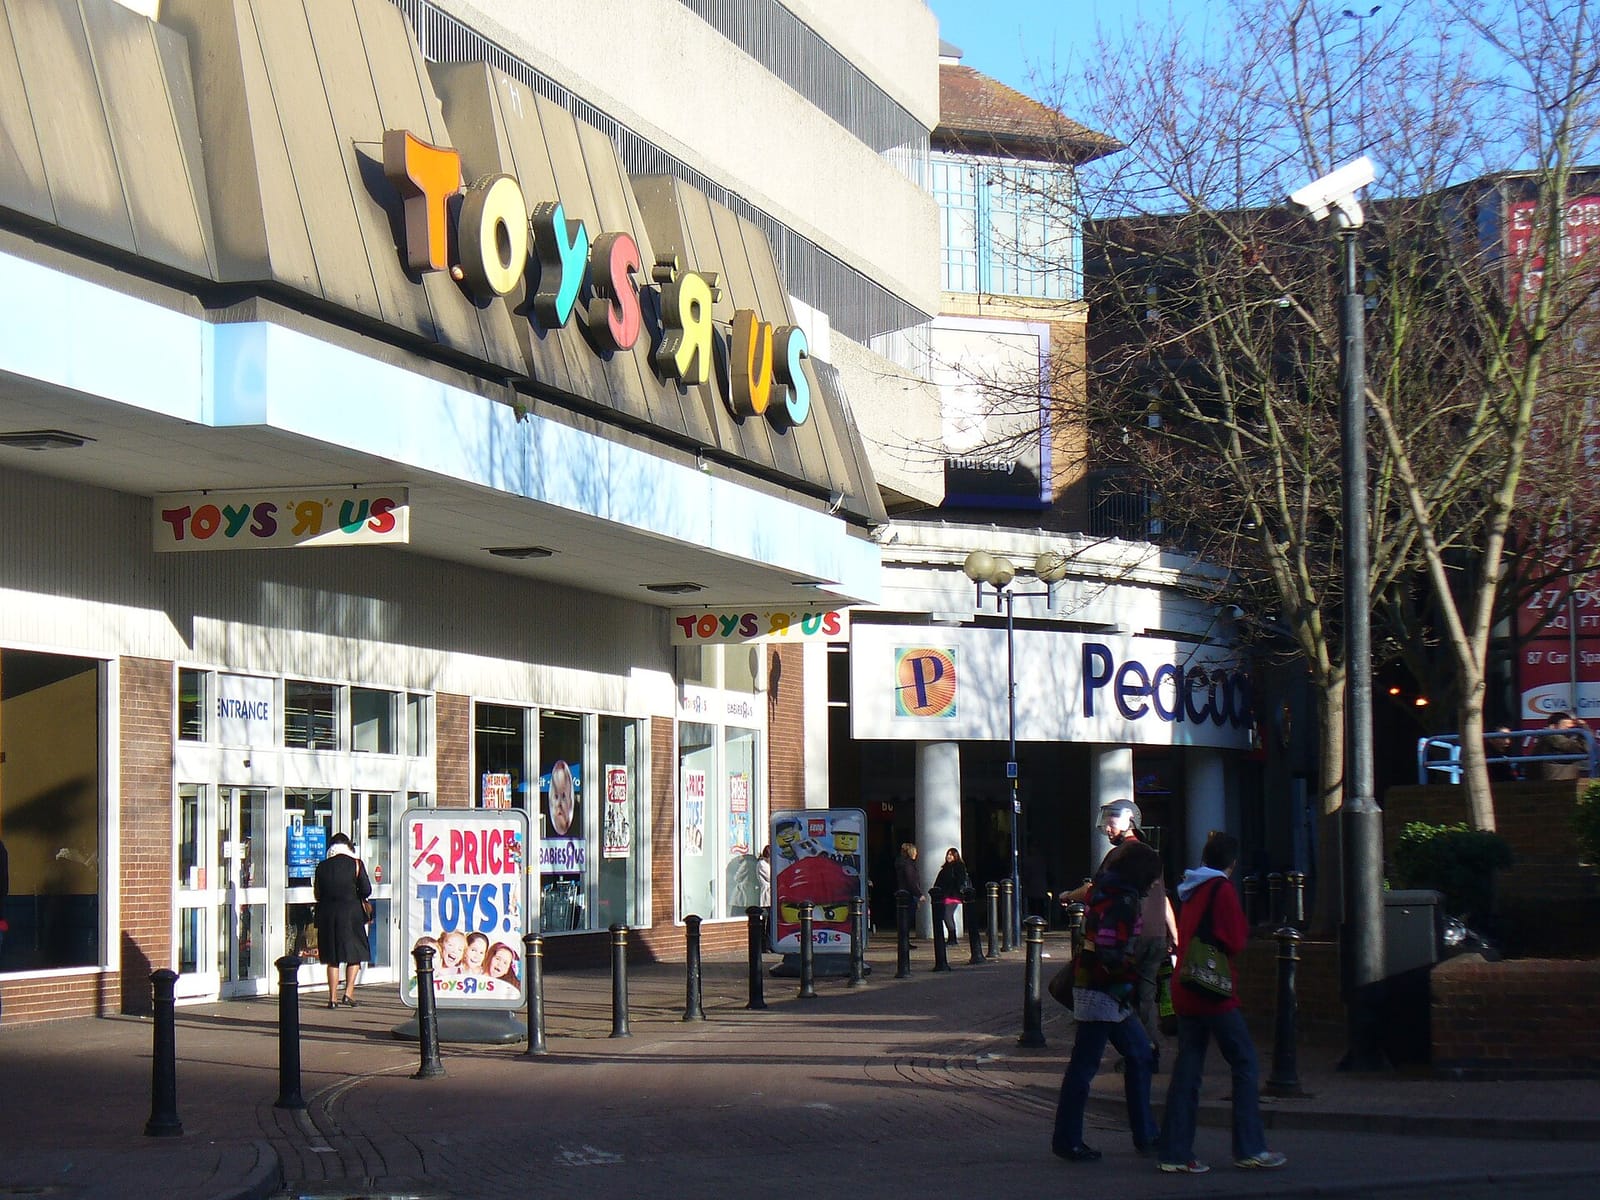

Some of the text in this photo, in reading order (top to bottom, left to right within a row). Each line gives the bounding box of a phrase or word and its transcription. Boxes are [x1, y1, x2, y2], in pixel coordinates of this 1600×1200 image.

[384, 129, 641, 351] TOYS
[729, 309, 811, 427] US
[950, 457, 1016, 475] Thursday
[162, 502, 277, 541] TOYS
[338, 497, 396, 534] US
[676, 613, 758, 638] TOYS
[801, 611, 841, 636] US
[1527, 651, 1542, 664] 87
[1547, 651, 1568, 664] Car
[450, 829, 515, 876] PRICE
[416, 883, 511, 934] TOYS!
